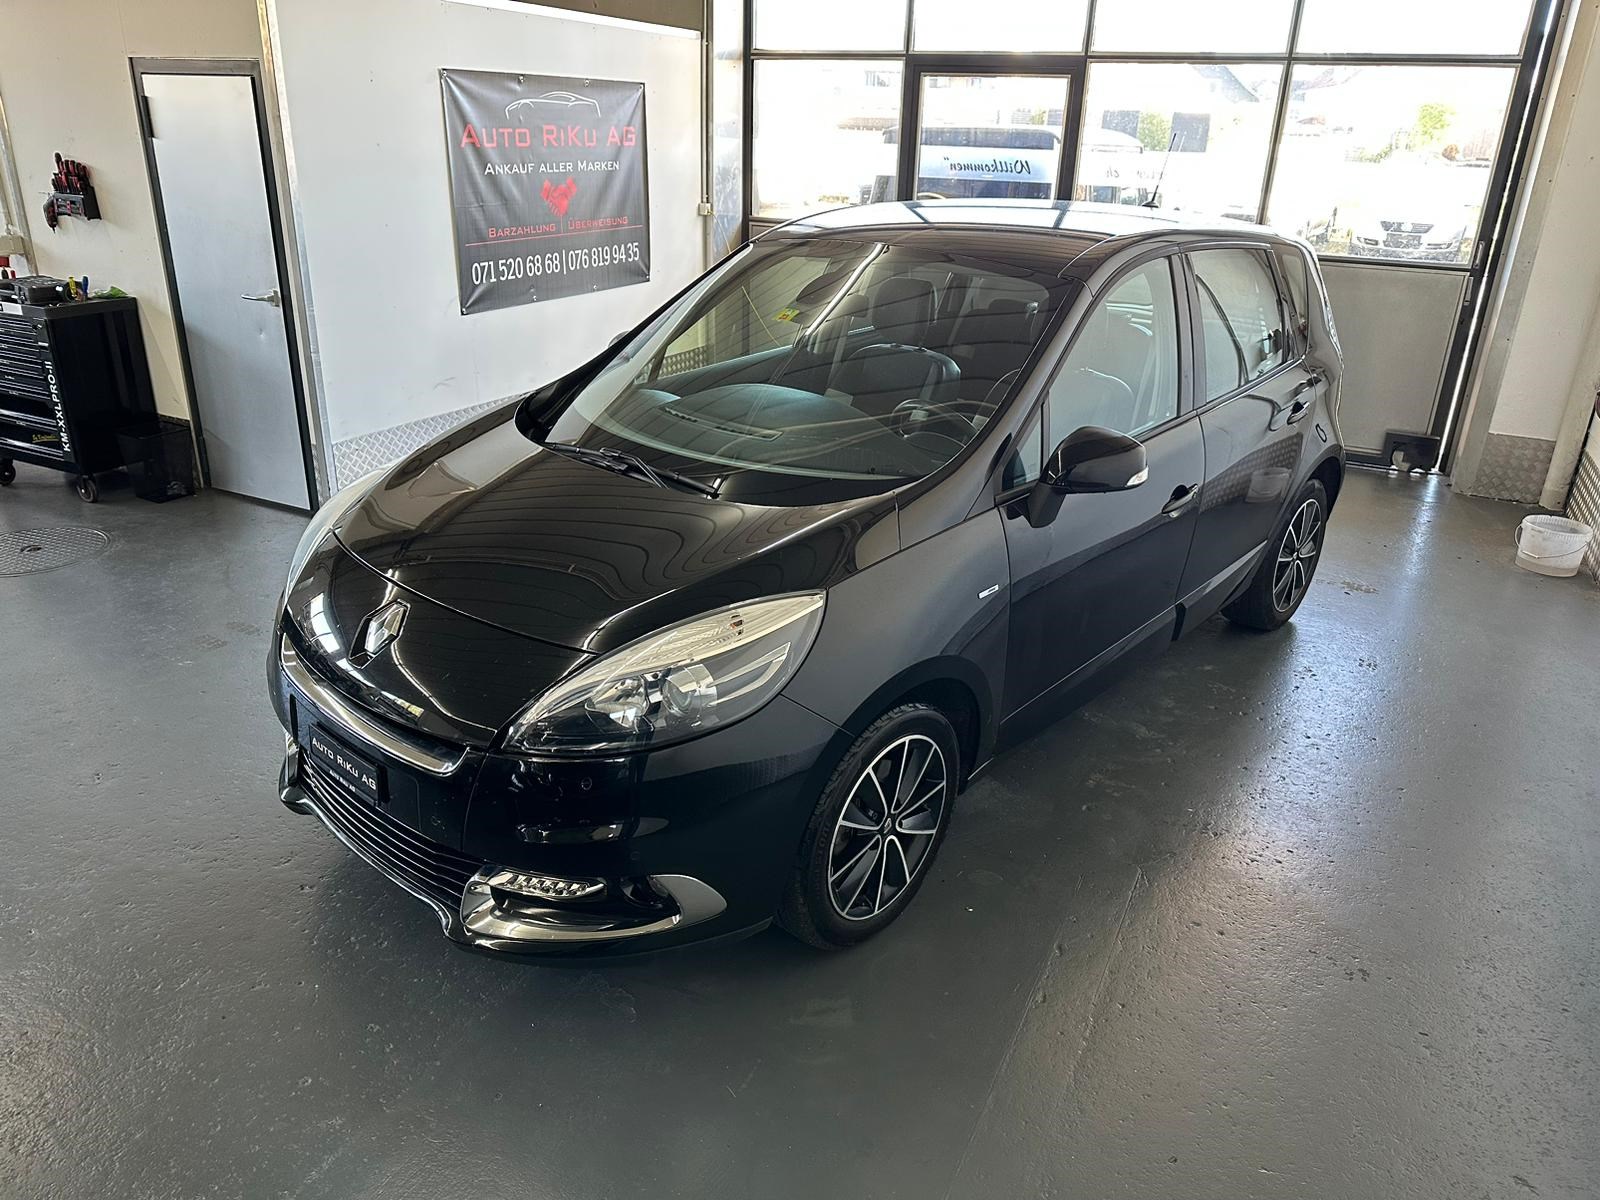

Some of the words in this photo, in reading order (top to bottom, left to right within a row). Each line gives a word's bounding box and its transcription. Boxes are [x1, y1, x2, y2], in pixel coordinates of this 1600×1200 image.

[606, 126, 637, 147] AG
[484, 162, 535, 176] ANKAUF
[577, 160, 620, 172] MARKEN
[488, 222, 556, 238] BARZAHLUNG
[472, 262, 497, 285] 071
[499, 258, 523, 281] 520
[526, 254, 542, 277] 68
[545, 252, 561, 274] 68
[568, 248, 589, 271] 076
[591, 245, 610, 267] 819
[612, 243, 626, 265] 94
[627, 242, 640, 262] 35
[361, 774, 377, 791] AG
